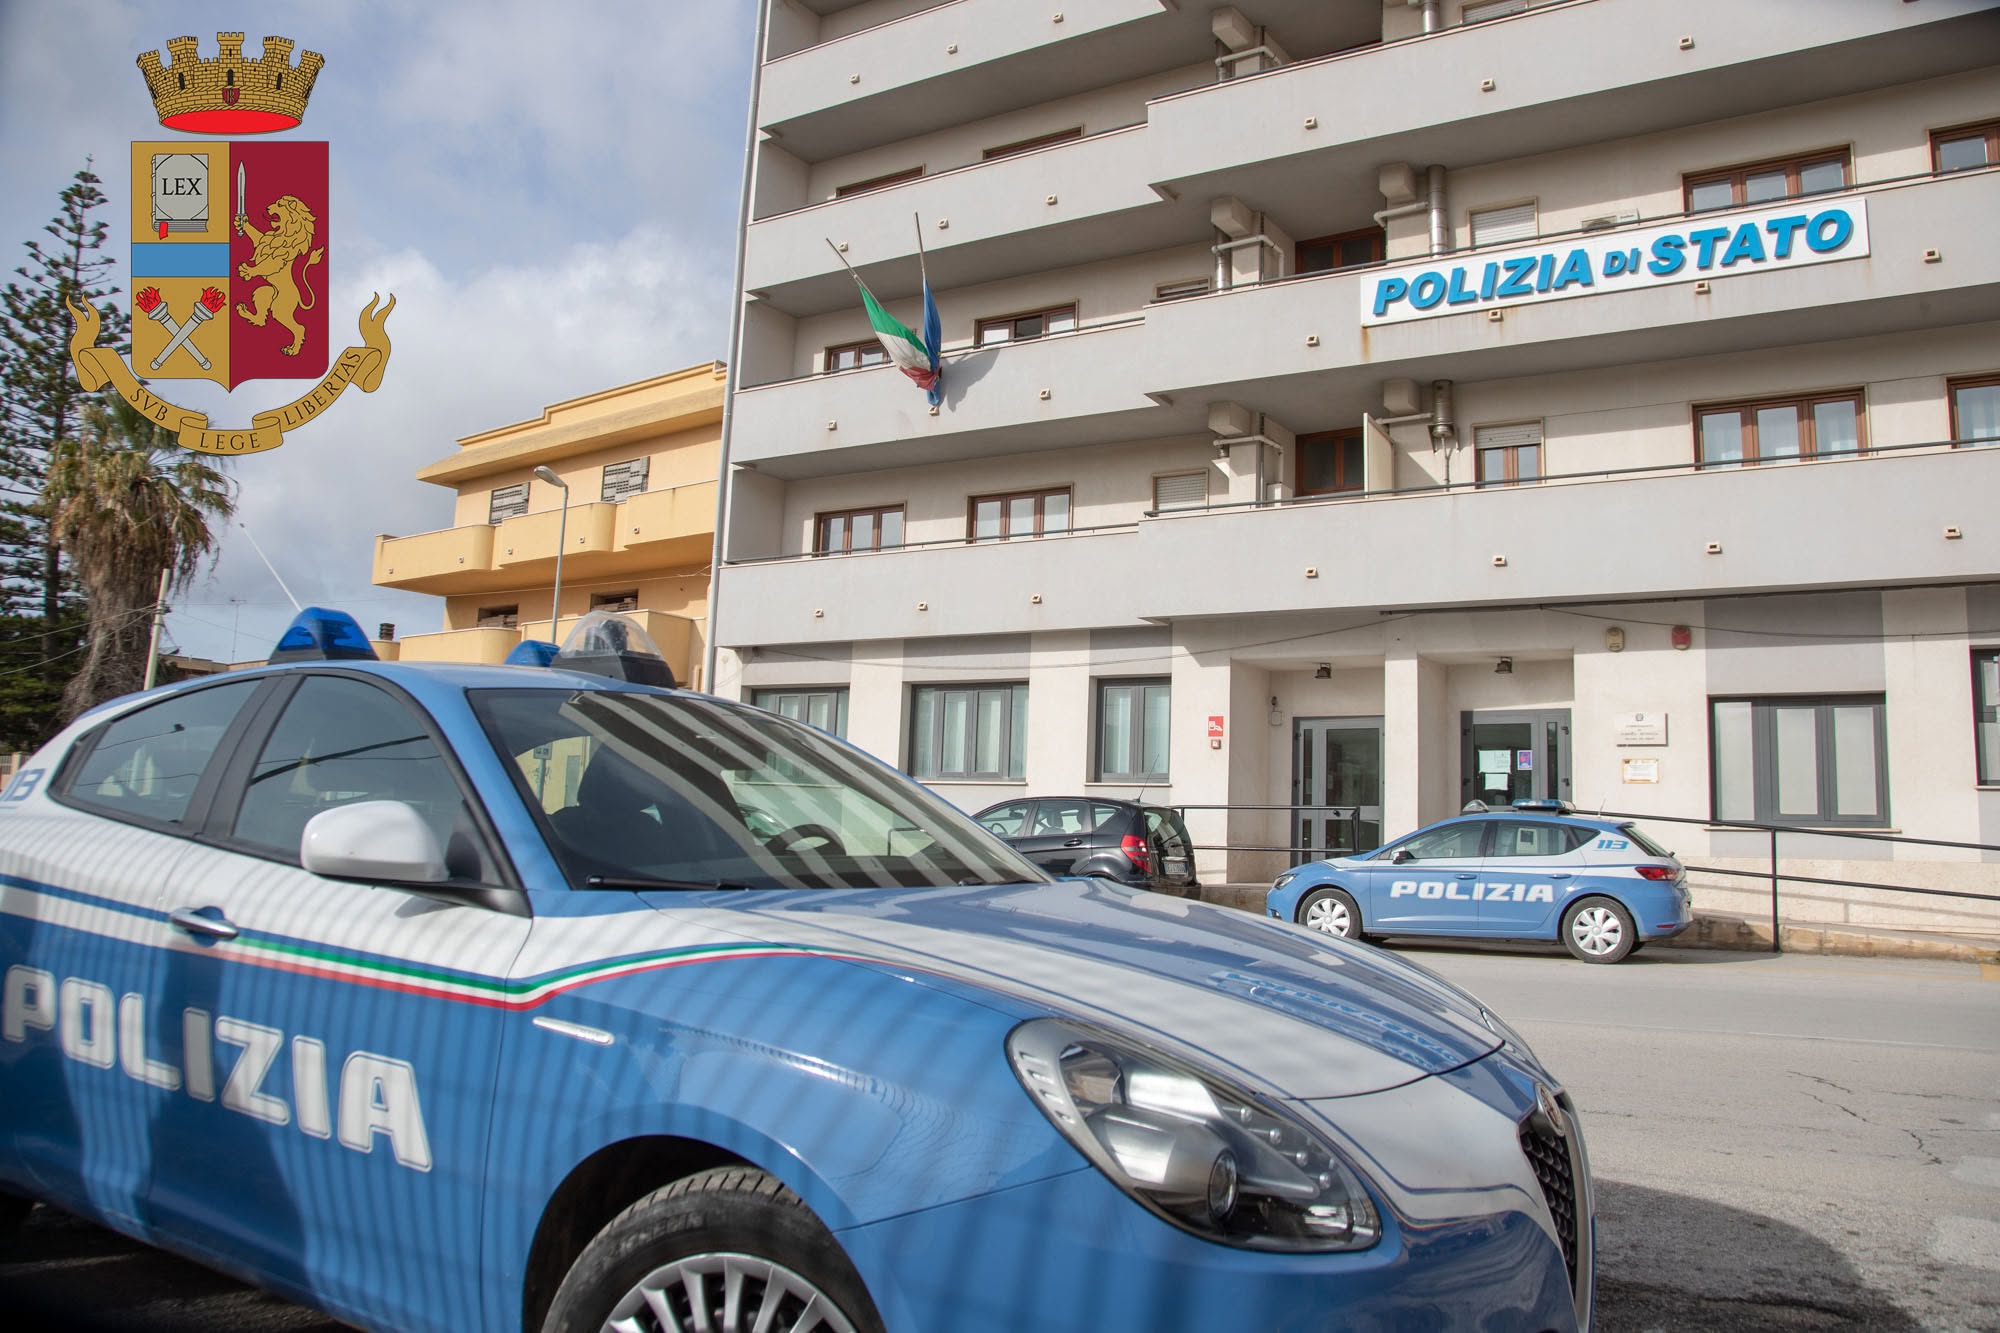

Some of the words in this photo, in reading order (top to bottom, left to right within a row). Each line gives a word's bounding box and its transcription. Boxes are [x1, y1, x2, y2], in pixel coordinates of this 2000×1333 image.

[1373, 248, 1594, 315] POLIZIA
[1602, 248, 1640, 276] DI
[1647, 209, 1852, 275] STATO
[1597, 839, 1629, 849] 113
[1390, 880, 1554, 903] POLIZIA
[3, 964, 433, 1172] POLIZIA
